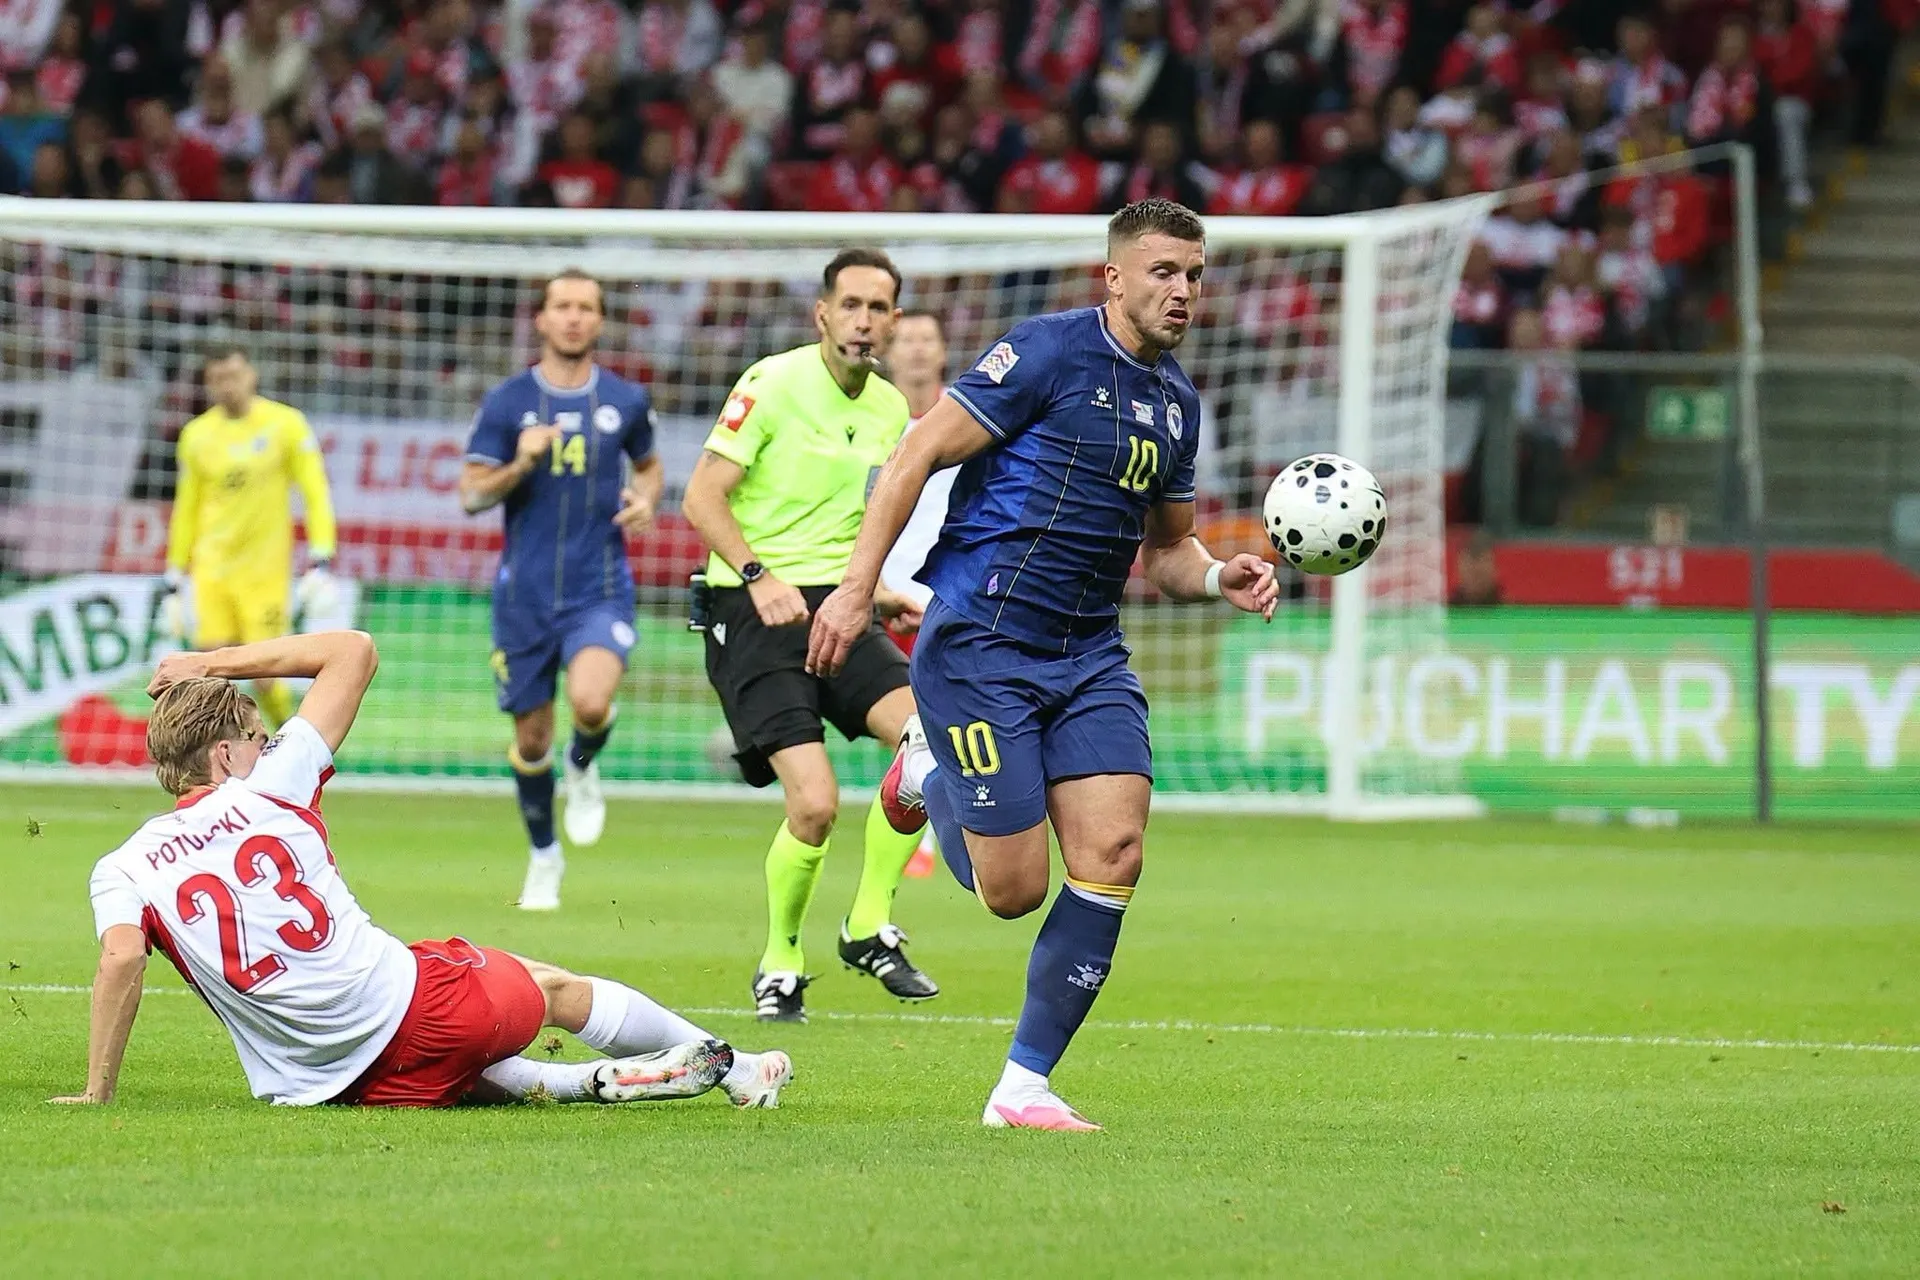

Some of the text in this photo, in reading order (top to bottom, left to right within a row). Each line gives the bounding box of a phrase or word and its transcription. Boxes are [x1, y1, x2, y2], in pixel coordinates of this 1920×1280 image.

[551, 434, 587, 476] 14
[1118, 435, 1158, 492] 10
[1245, 652, 1729, 764] PUCHAR
[948, 721, 1001, 777] 10
[176, 834, 336, 995] 23
